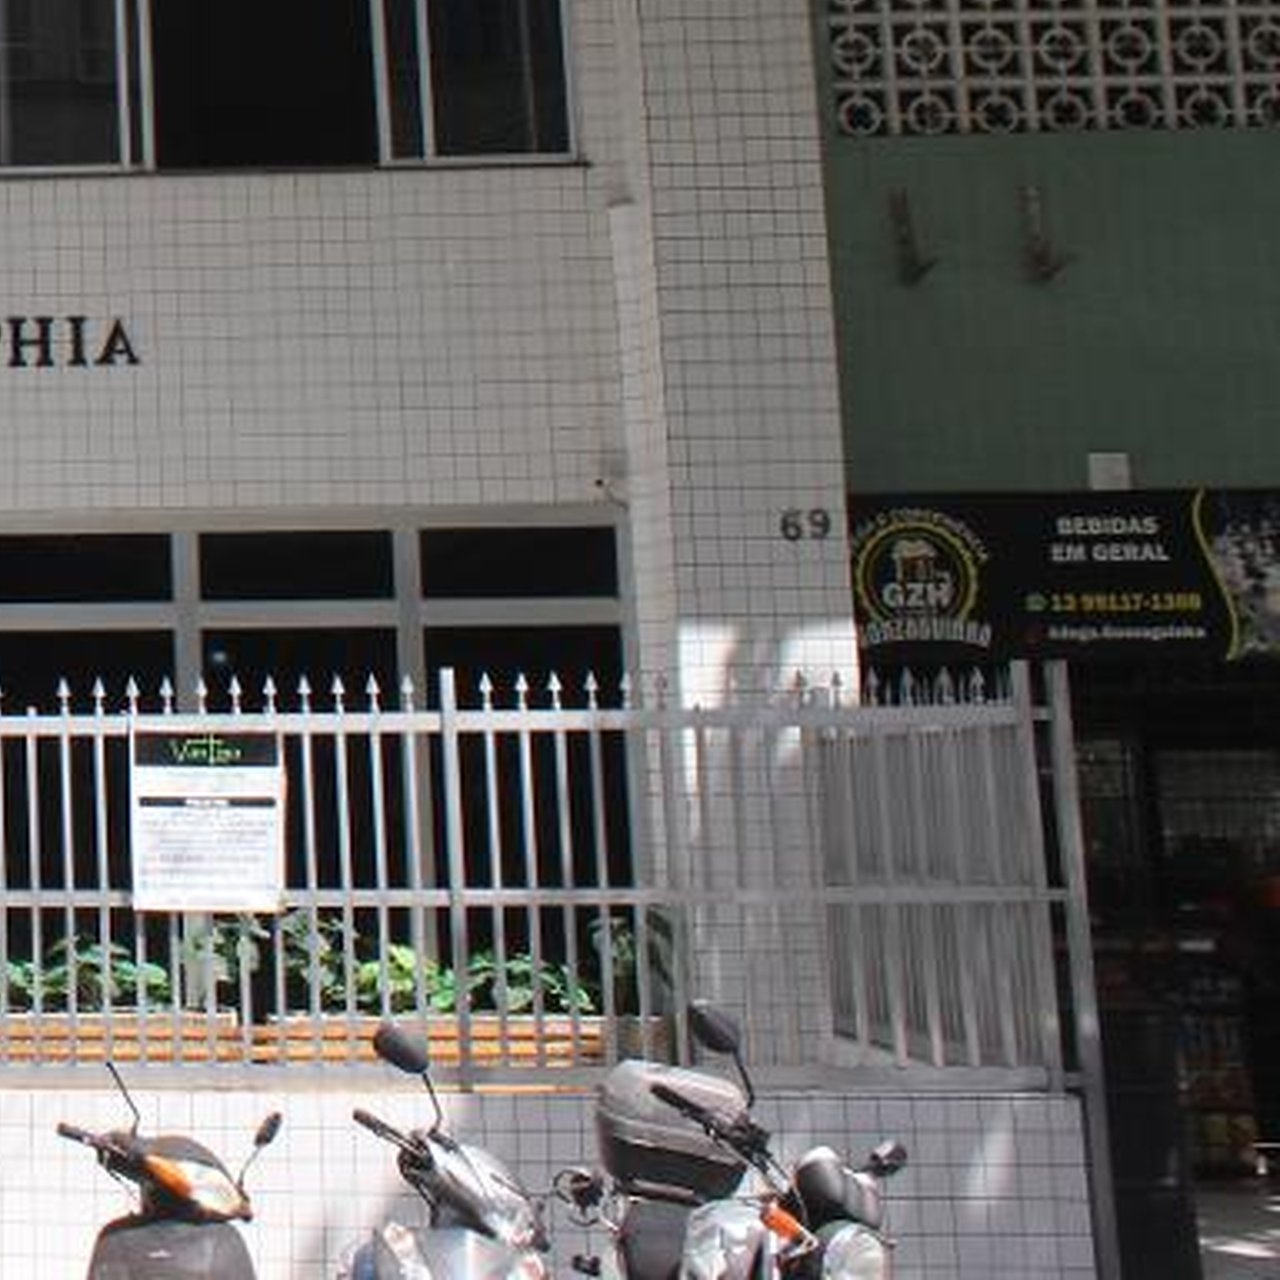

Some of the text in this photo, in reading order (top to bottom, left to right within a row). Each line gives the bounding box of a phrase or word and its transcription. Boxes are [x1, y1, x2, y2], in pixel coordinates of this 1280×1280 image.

[780, 508, 831, 542] 69
[1056, 517, 1159, 535] BEBIDAS
[1051, 543, 1170, 562] EM GERAL
